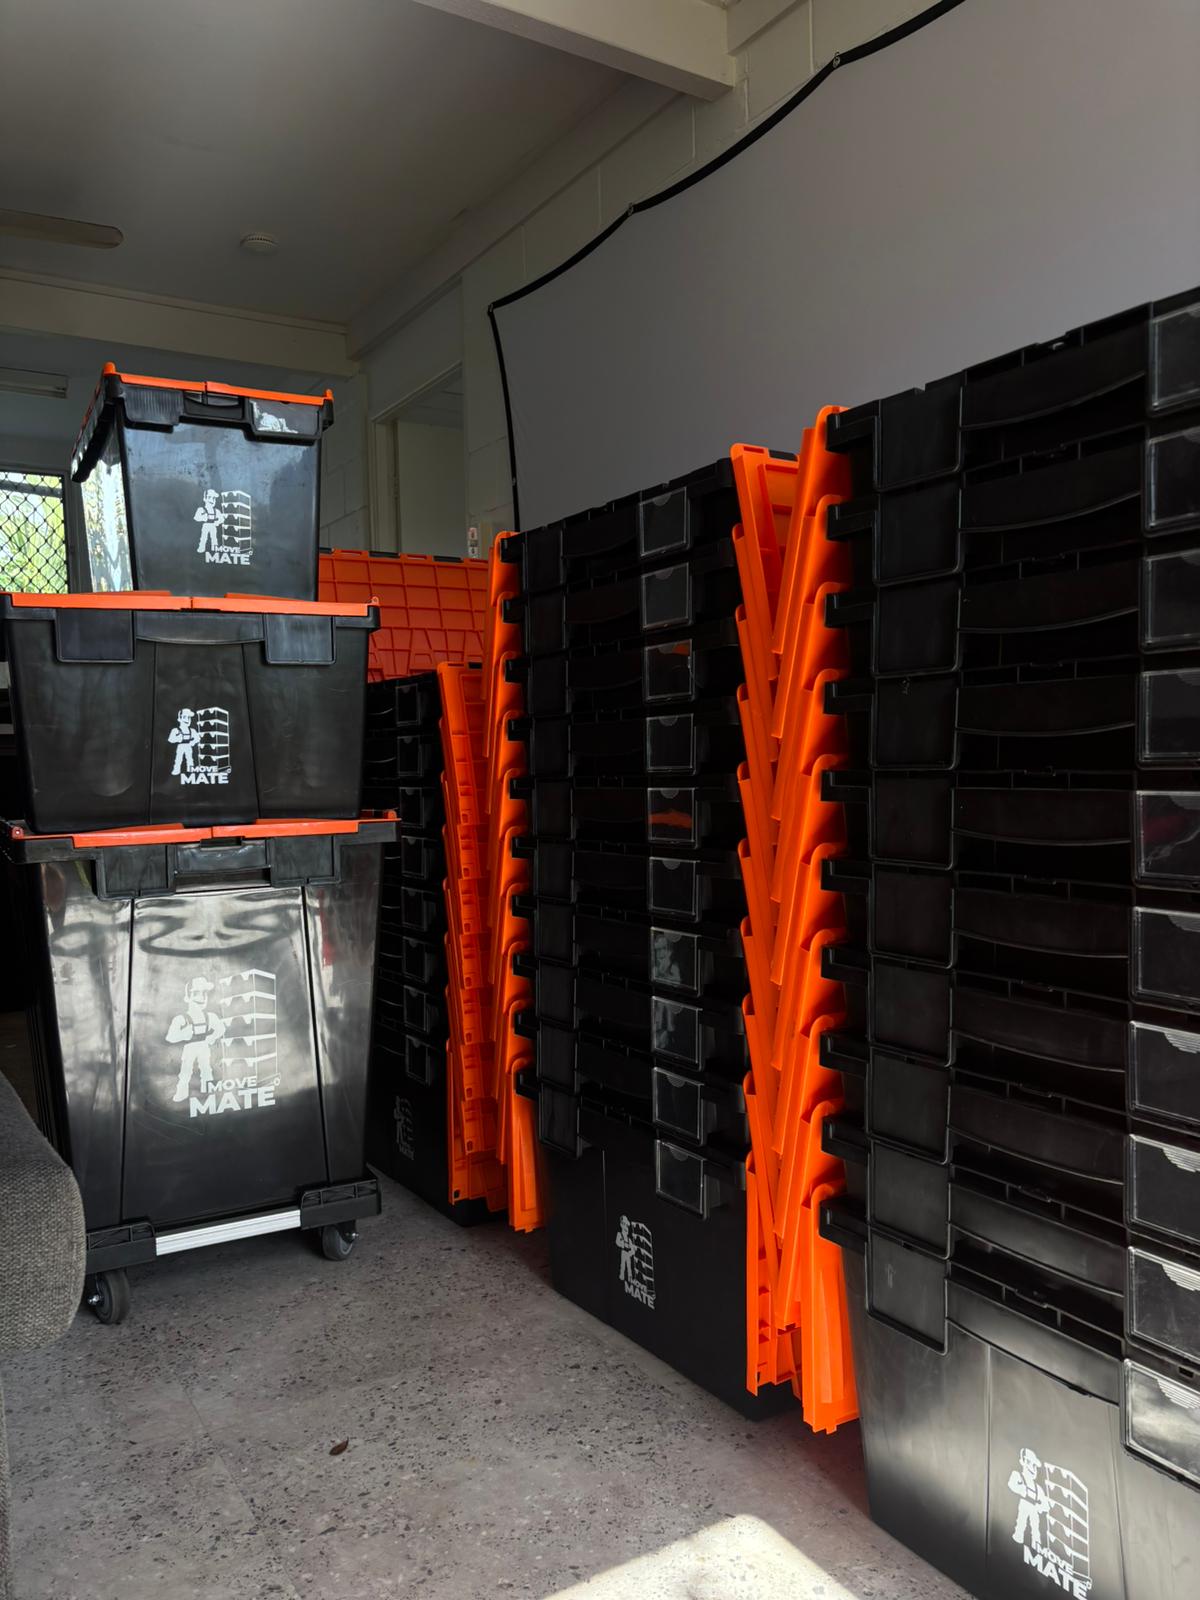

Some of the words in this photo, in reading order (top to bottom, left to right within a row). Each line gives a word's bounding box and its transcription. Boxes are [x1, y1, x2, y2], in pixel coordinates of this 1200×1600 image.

[215, 545, 240, 553] MOVE
[205, 551, 250, 565] MATE
[190, 765, 218, 773] MOVE
[180, 772, 229, 785] MATE
[207, 1076, 257, 1093] MOVE
[189, 1086, 276, 1118] MATE
[624, 1280, 655, 1310] MATE
[1036, 1541, 1073, 1576] MOVE
[1023, 1544, 1088, 1600] MATE
